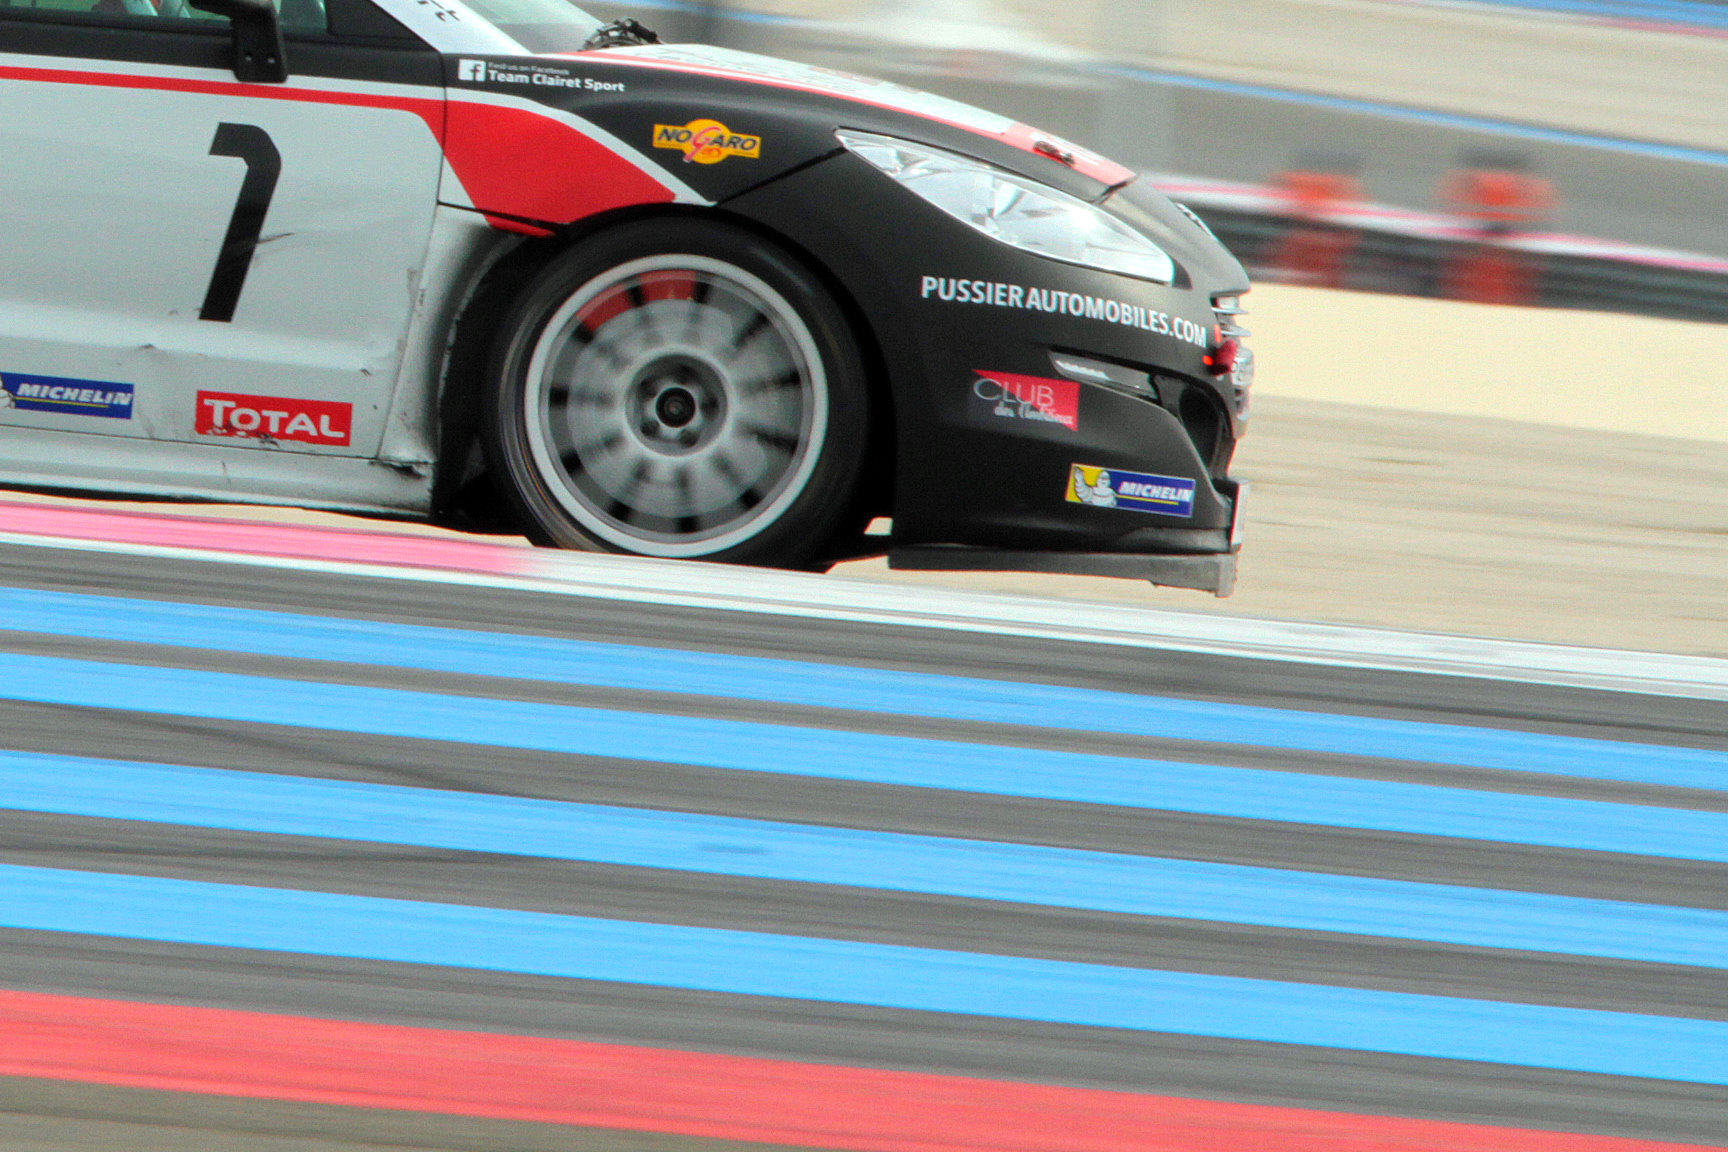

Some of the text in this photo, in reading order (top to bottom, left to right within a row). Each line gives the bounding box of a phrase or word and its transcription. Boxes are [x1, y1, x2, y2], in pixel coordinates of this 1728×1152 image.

[487, 69, 625, 92] Team Clairet Sport
[656, 125, 758, 163] NOGARO
[198, 121, 282, 322] 7
[921, 275, 1208, 348] PUSSIER AUTOMOBILES.COM
[15, 381, 134, 406] MICHELIN
[973, 378, 1055, 407] CLUB
[203, 398, 346, 439] TOTAL
[1118, 480, 1194, 503] MICHELIN
